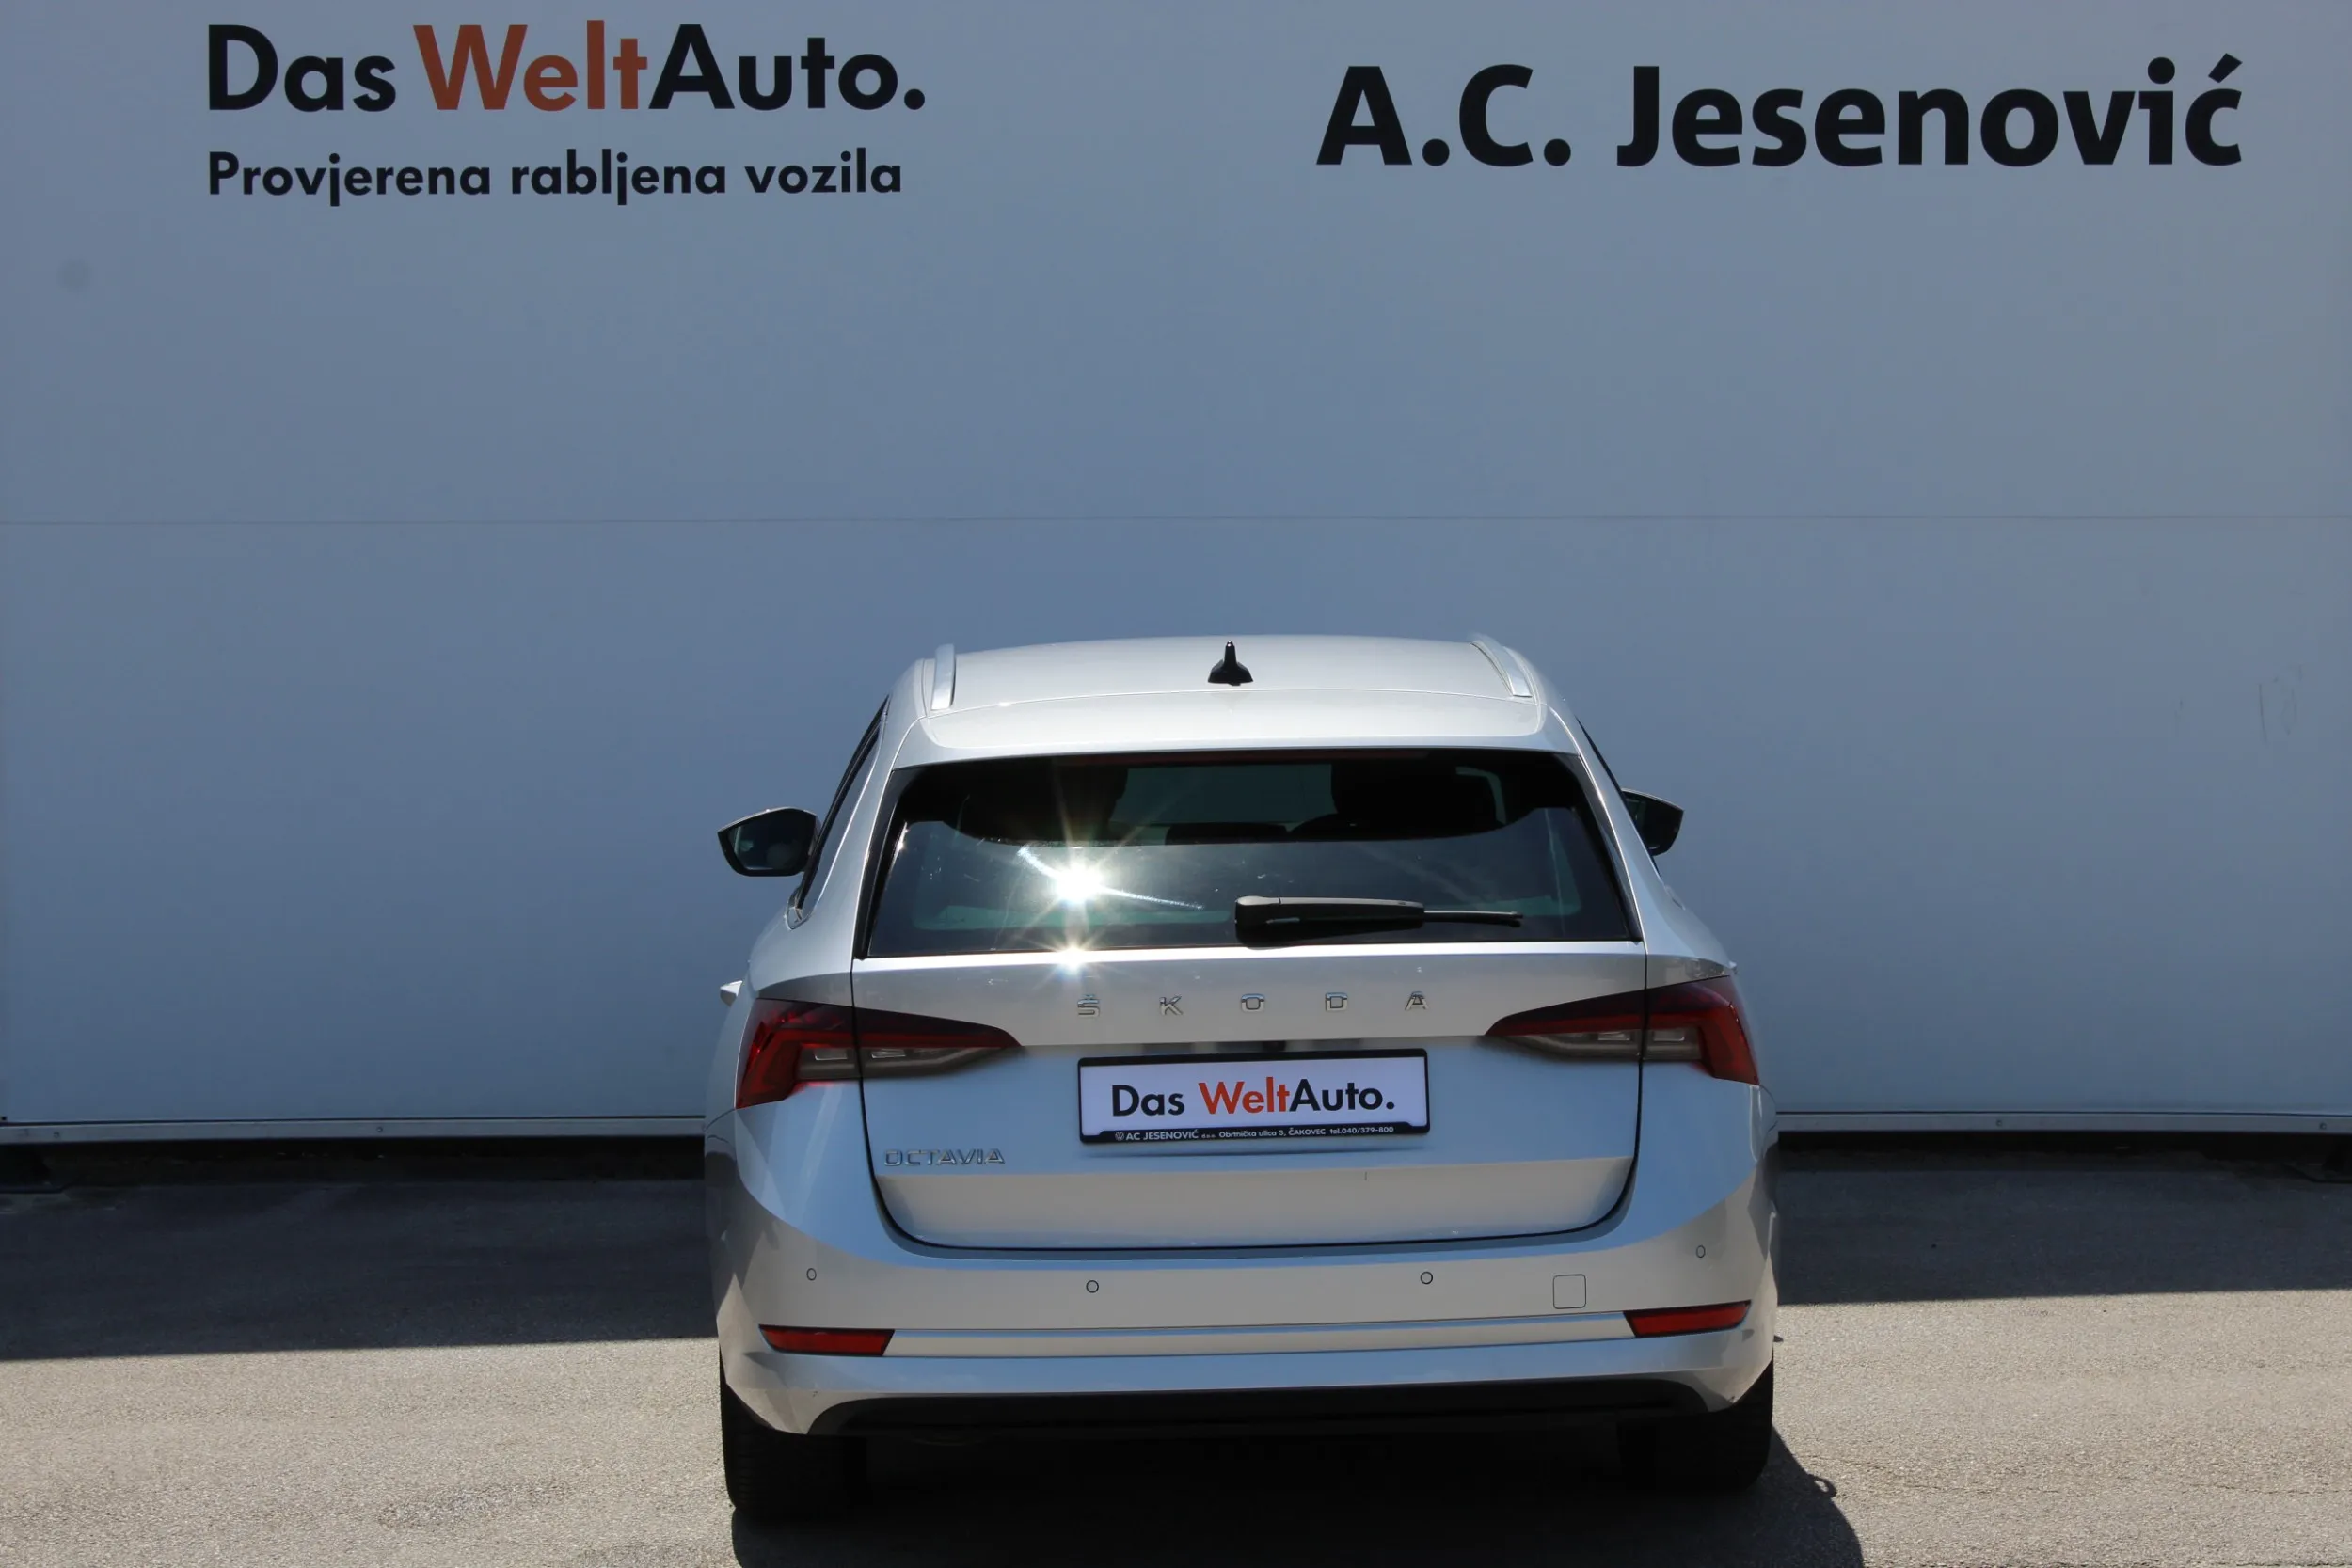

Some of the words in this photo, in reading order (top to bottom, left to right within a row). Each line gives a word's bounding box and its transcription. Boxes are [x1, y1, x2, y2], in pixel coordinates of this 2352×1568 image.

[208, 24, 396, 112] Das
[413, 20, 926, 112] WeltAuto.
[1317, 63, 1572, 166] A.C.
[1616, 53, 2243, 167] Jesenović
[209, 151, 491, 207] Provjerena
[512, 148, 727, 206] rabljena
[745, 147, 901, 194] vozila
[1112, 1085, 1185, 1117] Das
[1198, 1076, 1395, 1116] WeltAuto.
[883, 1148, 1006, 1166] OCTAVIA
[1125, 1132, 1141, 1141] AC
[1143, 1129, 1199, 1140] JESENOVIĆ
[1218, 1130, 1257, 1138] Obrtnička
[1288, 1127, 1326, 1136] ČAKOVEC
